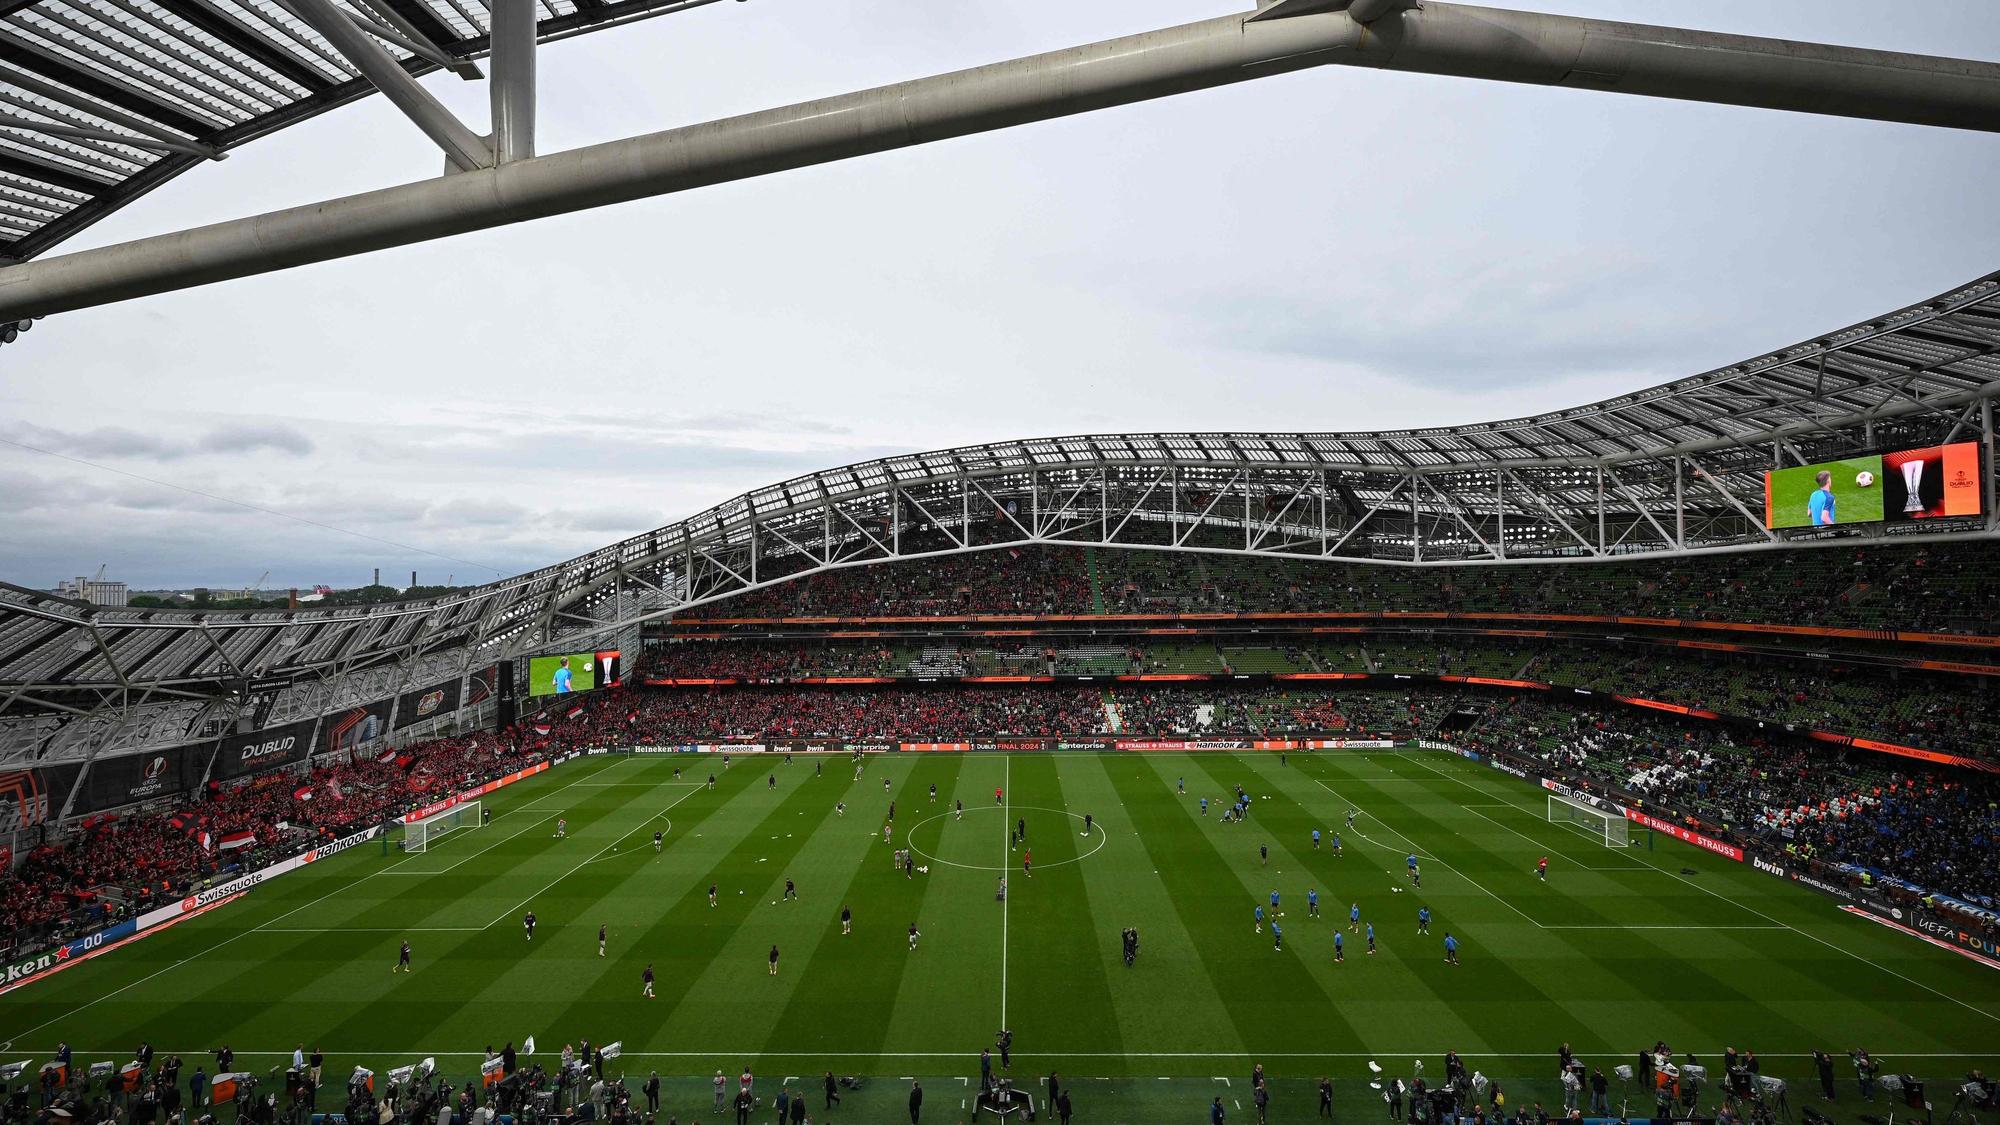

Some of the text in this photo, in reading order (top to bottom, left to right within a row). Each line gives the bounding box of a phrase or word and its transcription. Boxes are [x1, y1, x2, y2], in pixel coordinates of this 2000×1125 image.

[241, 736, 296, 760] DUBLIN
[588, 746, 608, 755] bwin
[634, 745, 673, 753] Heineken
[717, 744, 754, 753] Swissquote
[806, 744, 825, 752] bwin
[1059, 742, 1106, 750] enterprise
[1343, 740, 1381, 748] Swissquote
[129, 783, 162, 795] EUROPA
[461, 787, 483, 801] STRAUSS
[421, 801, 447, 817] STRAUSS
[1643, 816, 1676, 835] STRAUSS
[1697, 837, 1735, 857] STRAUSS
[1753, 856, 1784, 877] bwin
[197, 872, 263, 905] Swissquote
[1918, 918, 1955, 939] UEFA
